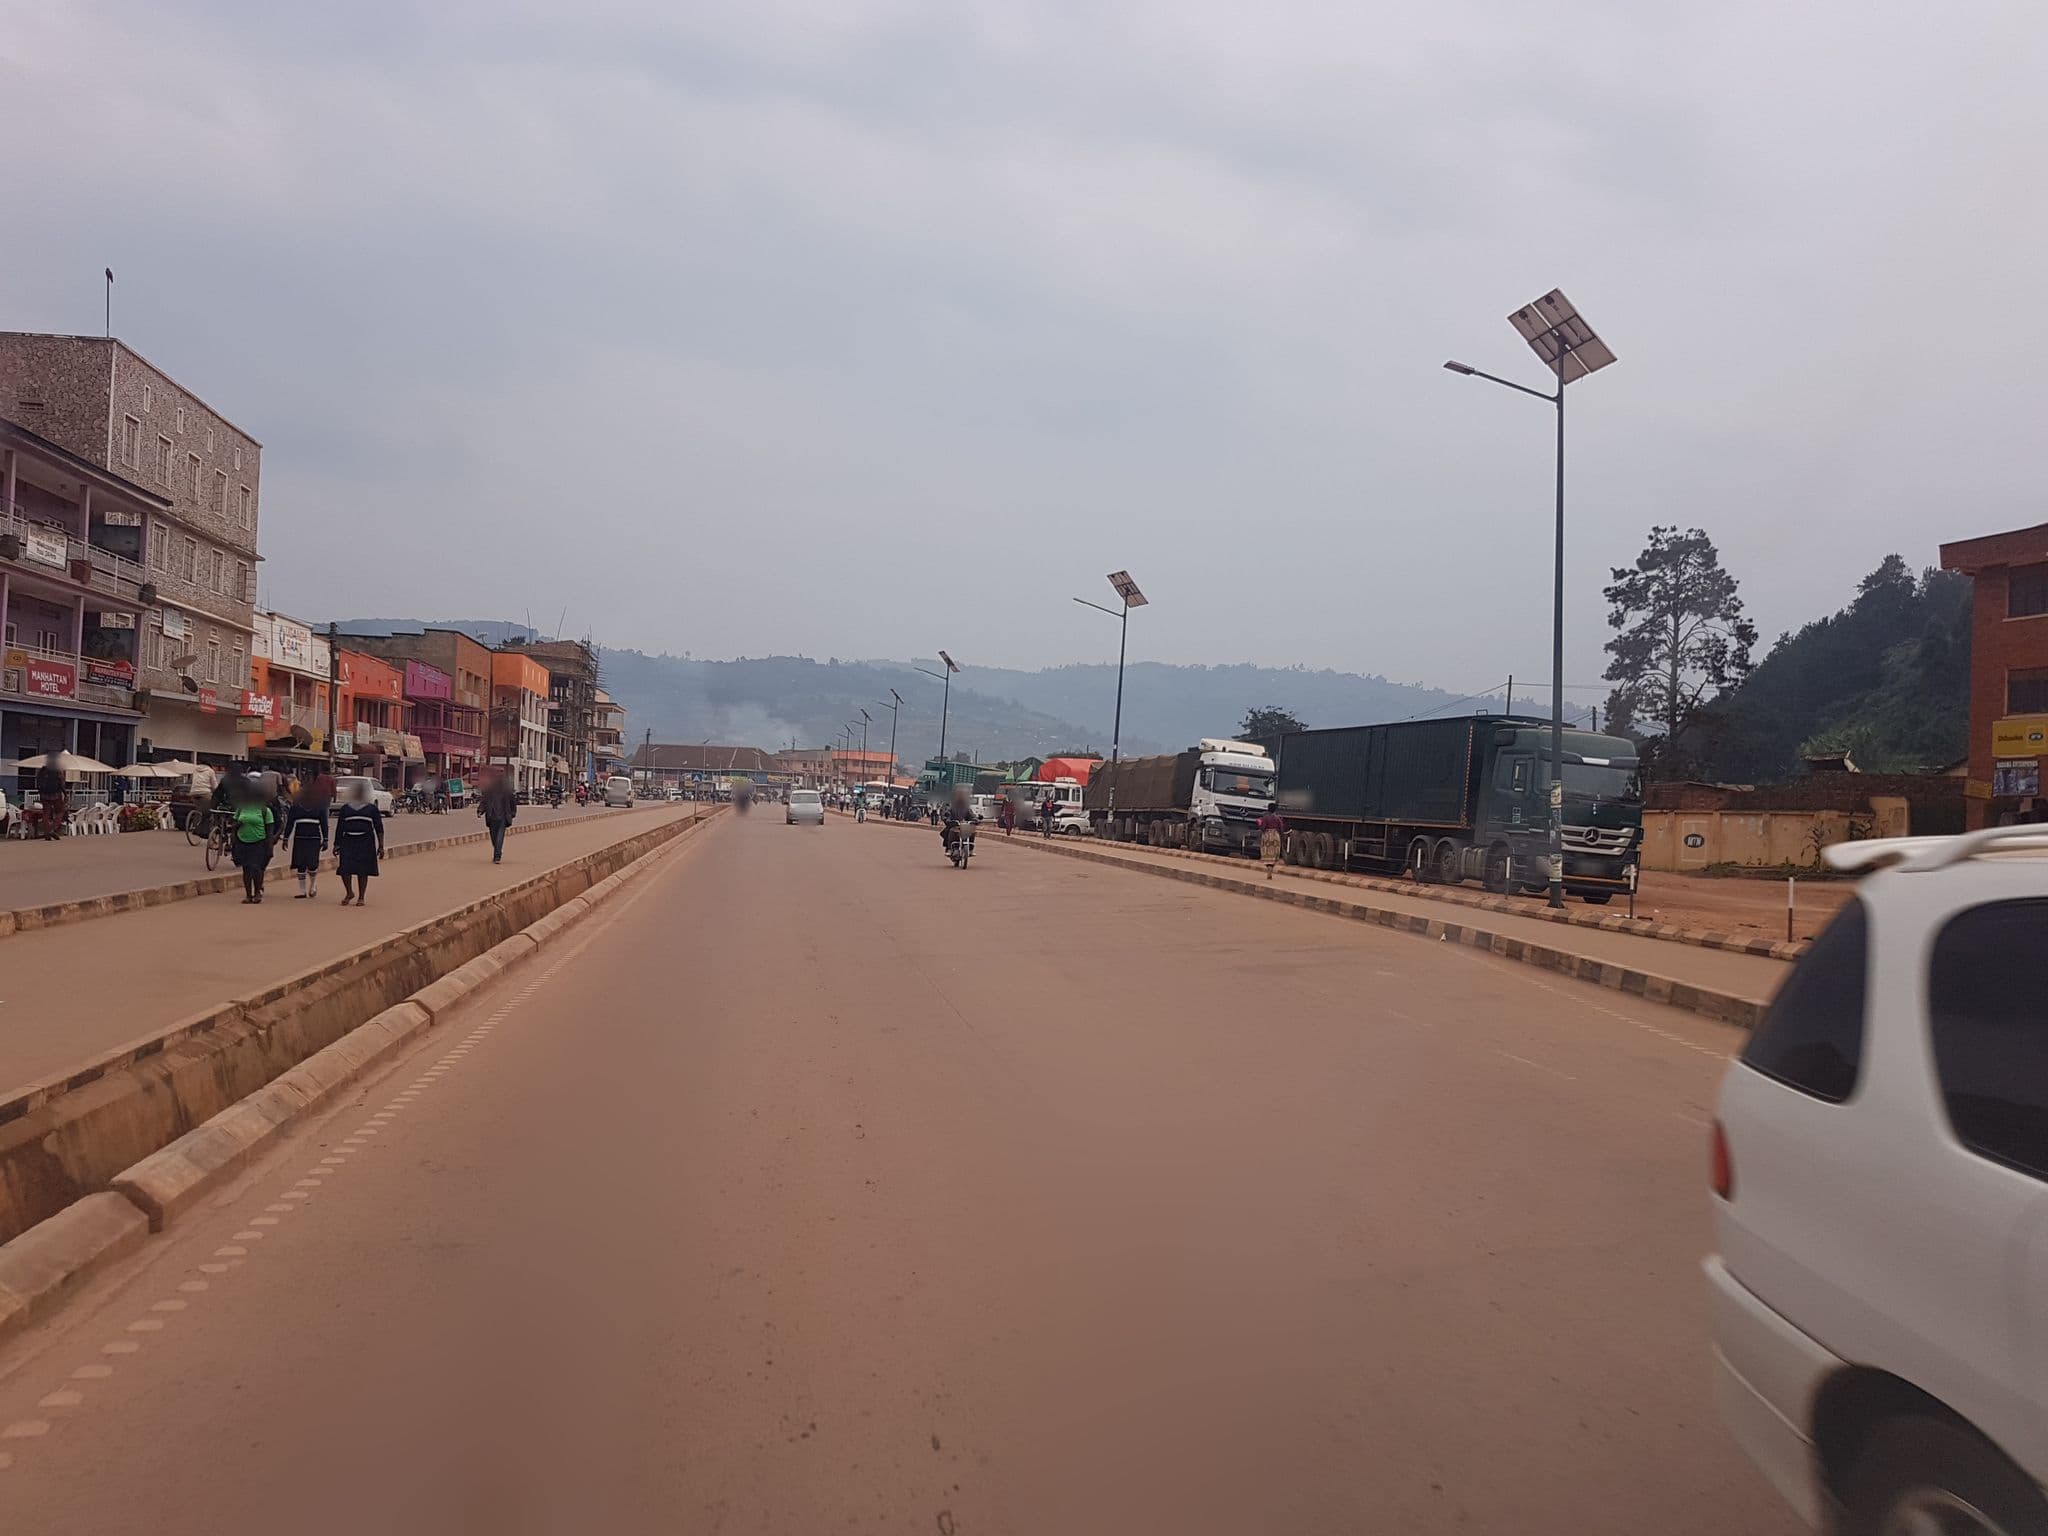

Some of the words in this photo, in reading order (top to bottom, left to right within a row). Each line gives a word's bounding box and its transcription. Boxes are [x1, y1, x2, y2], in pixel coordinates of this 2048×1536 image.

[31, 670, 68, 685] MANHATTAN
[40, 681, 60, 693] HOTEL
[248, 692, 274, 715] TopBet
